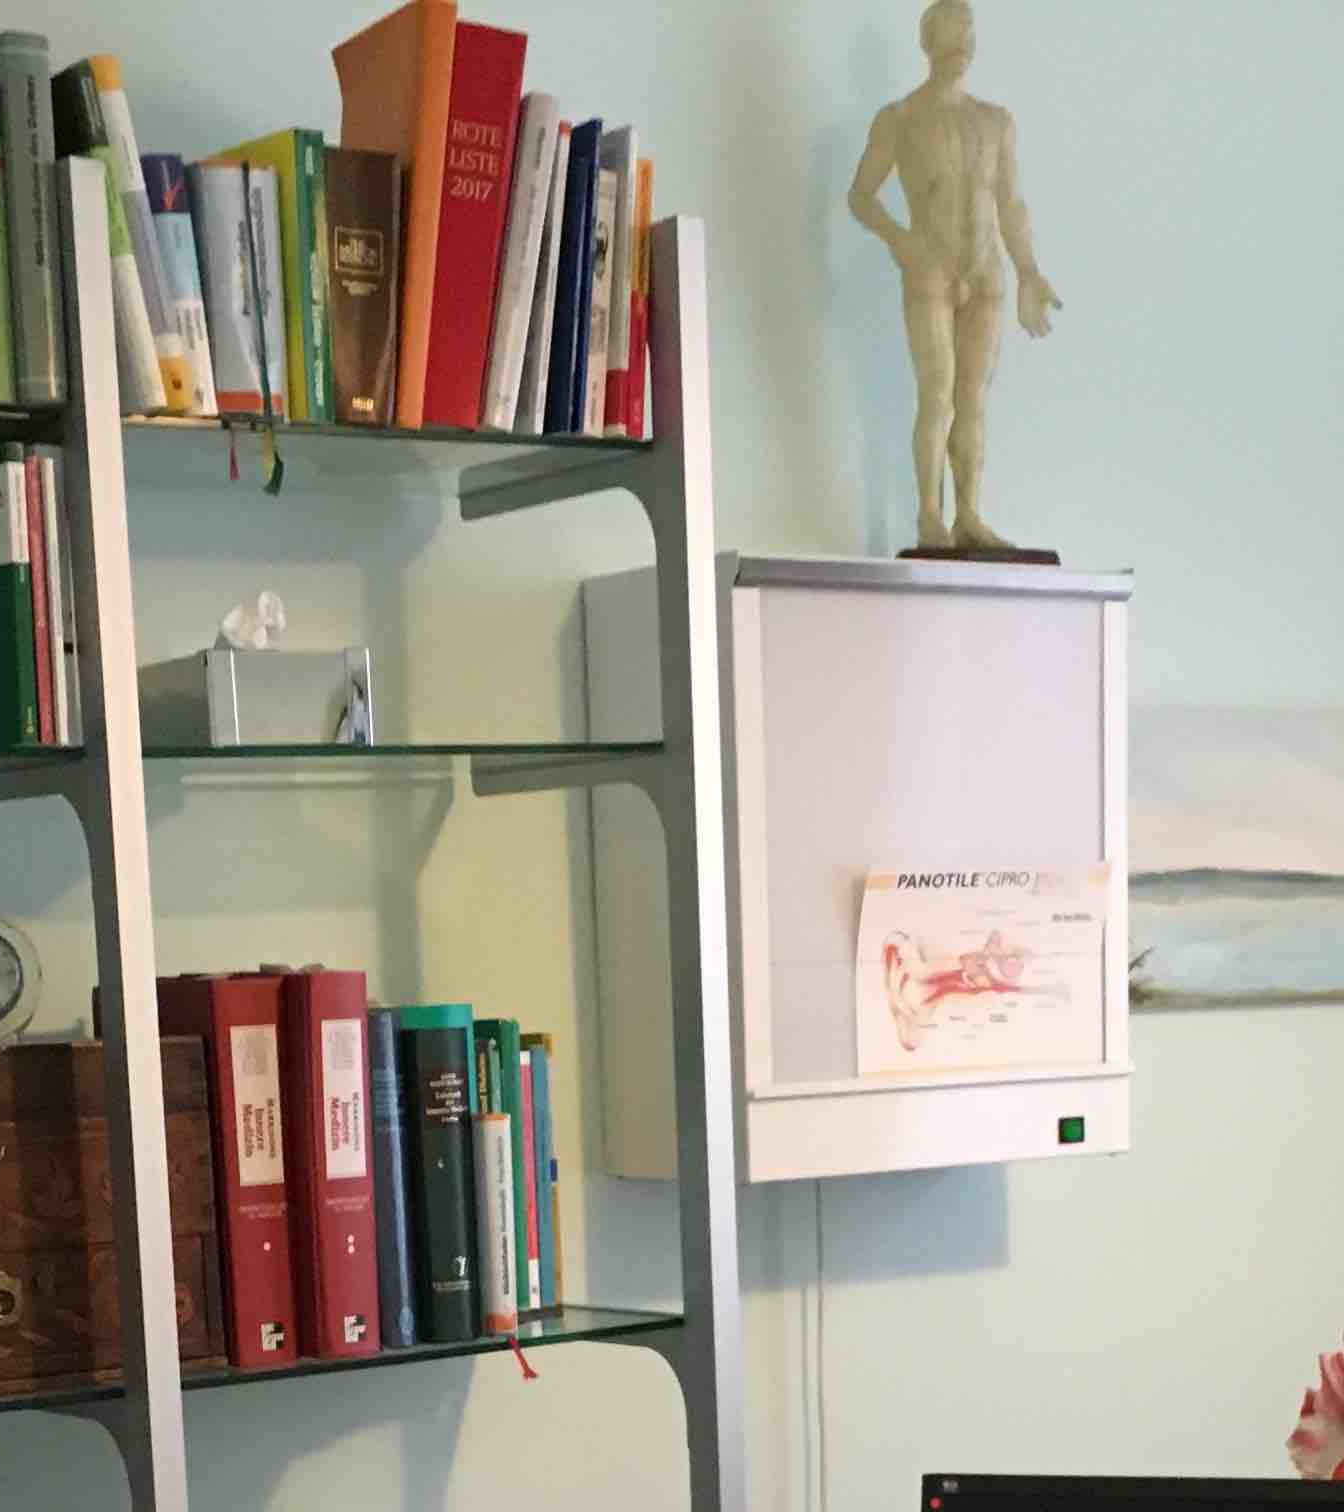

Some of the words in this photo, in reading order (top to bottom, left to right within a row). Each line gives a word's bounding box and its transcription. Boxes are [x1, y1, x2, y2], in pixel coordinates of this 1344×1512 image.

[452, 120, 502, 147] ROTE
[449, 146, 499, 177] LISTE
[450, 175, 493, 202] 2017
[896, 872, 980, 889] PANOTILE
[984, 871, 1030, 888] CIPRO
[243, 1103, 254, 1158] Medizin
[255, 1108, 264, 1151] Innere
[330, 1097, 340, 1152] Medizin
[342, 1101, 351, 1145] Innere
